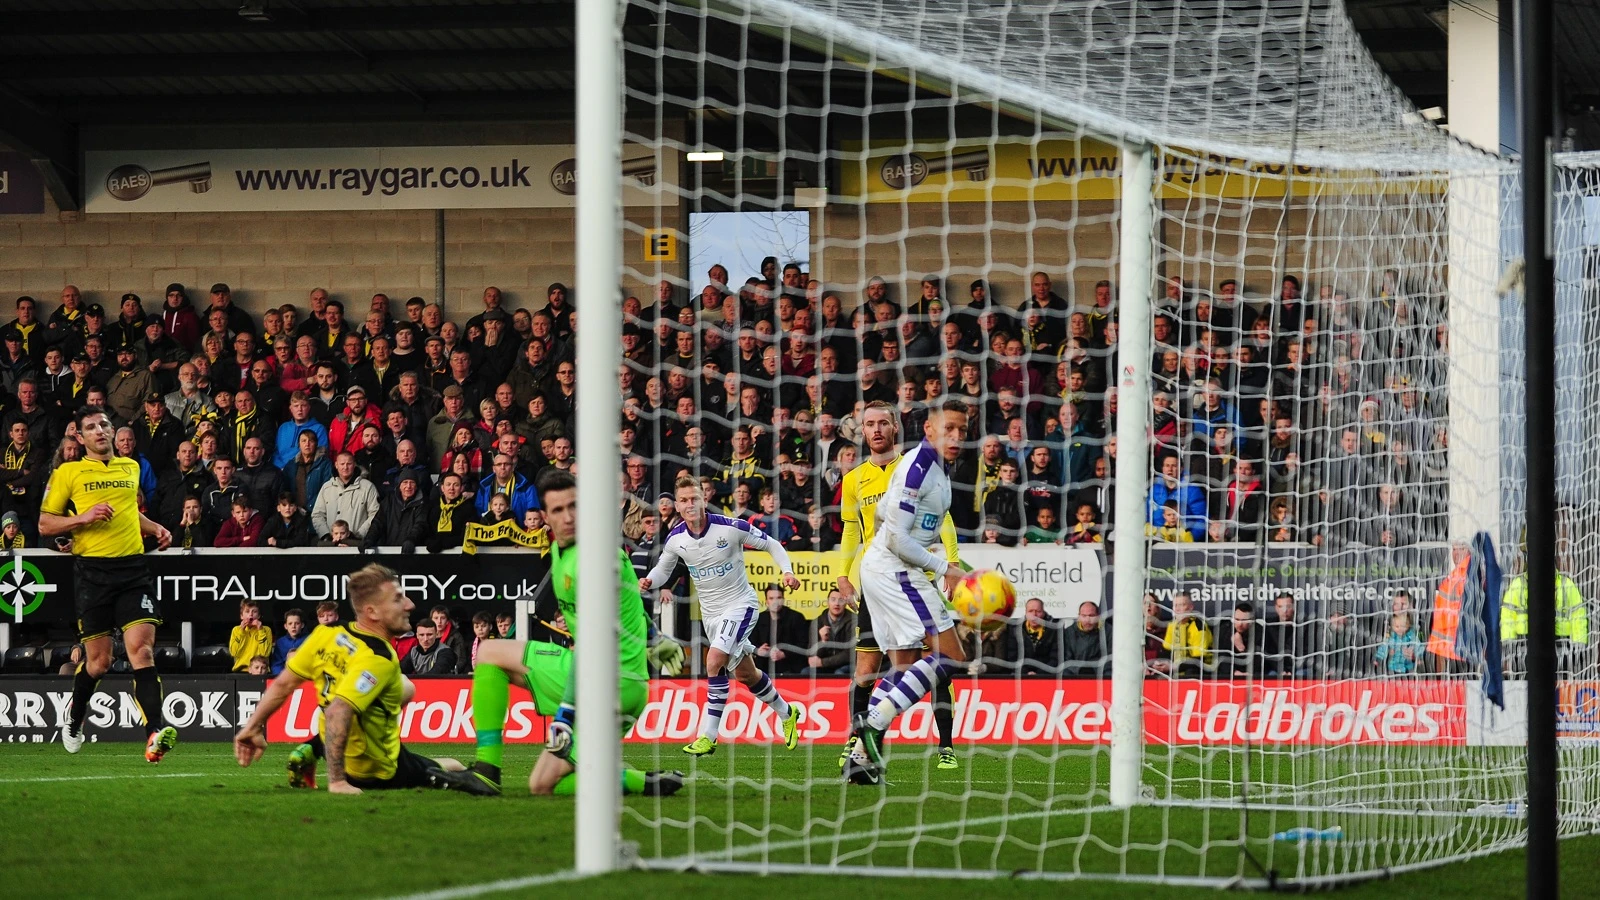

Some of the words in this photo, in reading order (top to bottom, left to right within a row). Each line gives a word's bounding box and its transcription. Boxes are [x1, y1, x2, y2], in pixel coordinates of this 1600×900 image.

[235, 159, 532, 196] www.raygar.co.uk
[884, 160, 923, 180] RAES
[110, 174, 147, 192] RAES
[651, 234, 669, 255] E
[83, 480, 135, 493] TEMPOBET
[473, 527, 494, 539] The
[497, 525, 538, 545] Brewers
[779, 561, 830, 575] lbion
[995, 562, 1083, 583] Ashfield
[801, 579, 838, 592] Trus
[141, 594, 154, 613] 4
[720, 619, 737, 637] 11
[88, 691, 265, 728] SMOKE
[884, 689, 1112, 741] abroke
[1178, 690, 1444, 741] Ladbrokes
